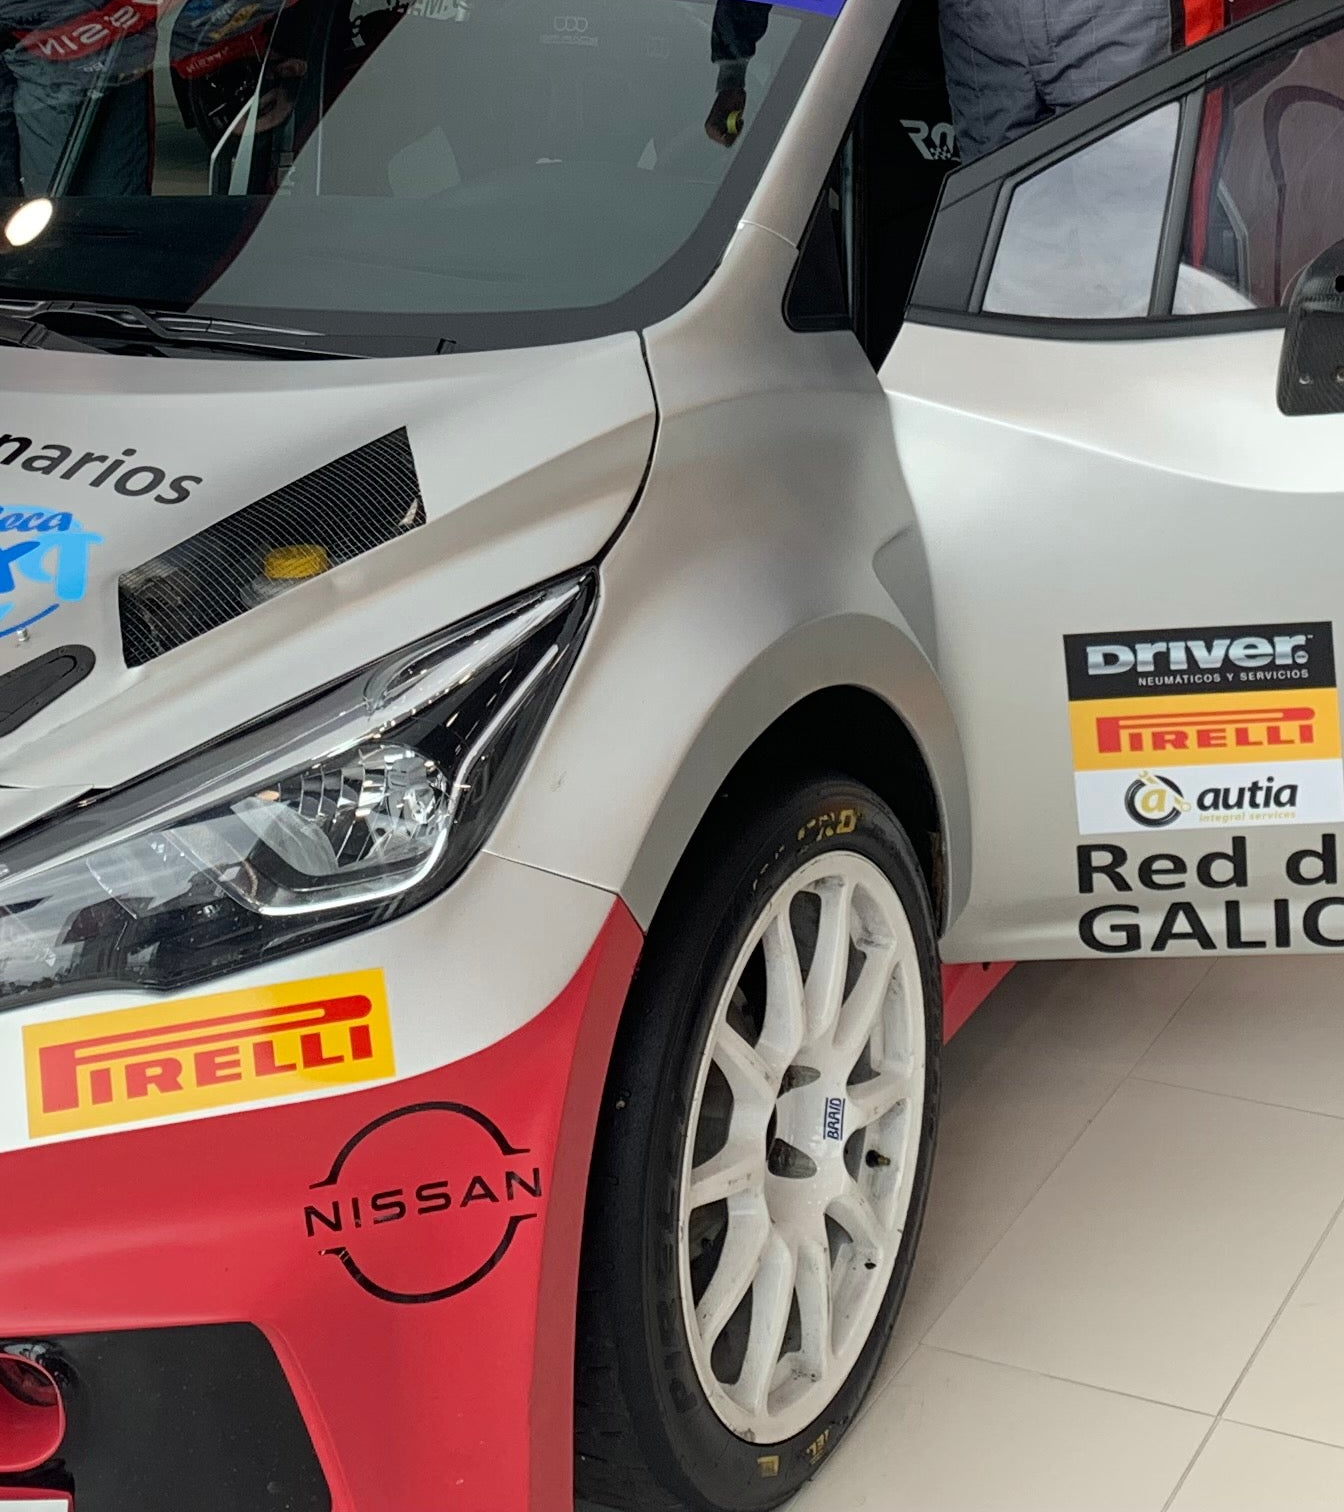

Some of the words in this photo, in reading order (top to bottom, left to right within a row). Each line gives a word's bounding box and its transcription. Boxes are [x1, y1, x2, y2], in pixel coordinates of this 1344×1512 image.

[1227, 672, 1233, 681] Y
[1240, 668, 1309, 682] SERVICIOS
[1096, 707, 1316, 754] PIRELLI
[1196, 775, 1299, 812] autia
[1199, 811, 1246, 824] integral
[1248, 810, 1296, 823] services
[1077, 835, 1249, 894] Red
[38, 993, 373, 1114] PIRELLI
[826, 1097, 843, 1141] BRAID
[303, 1167, 543, 1238] NISSAN
